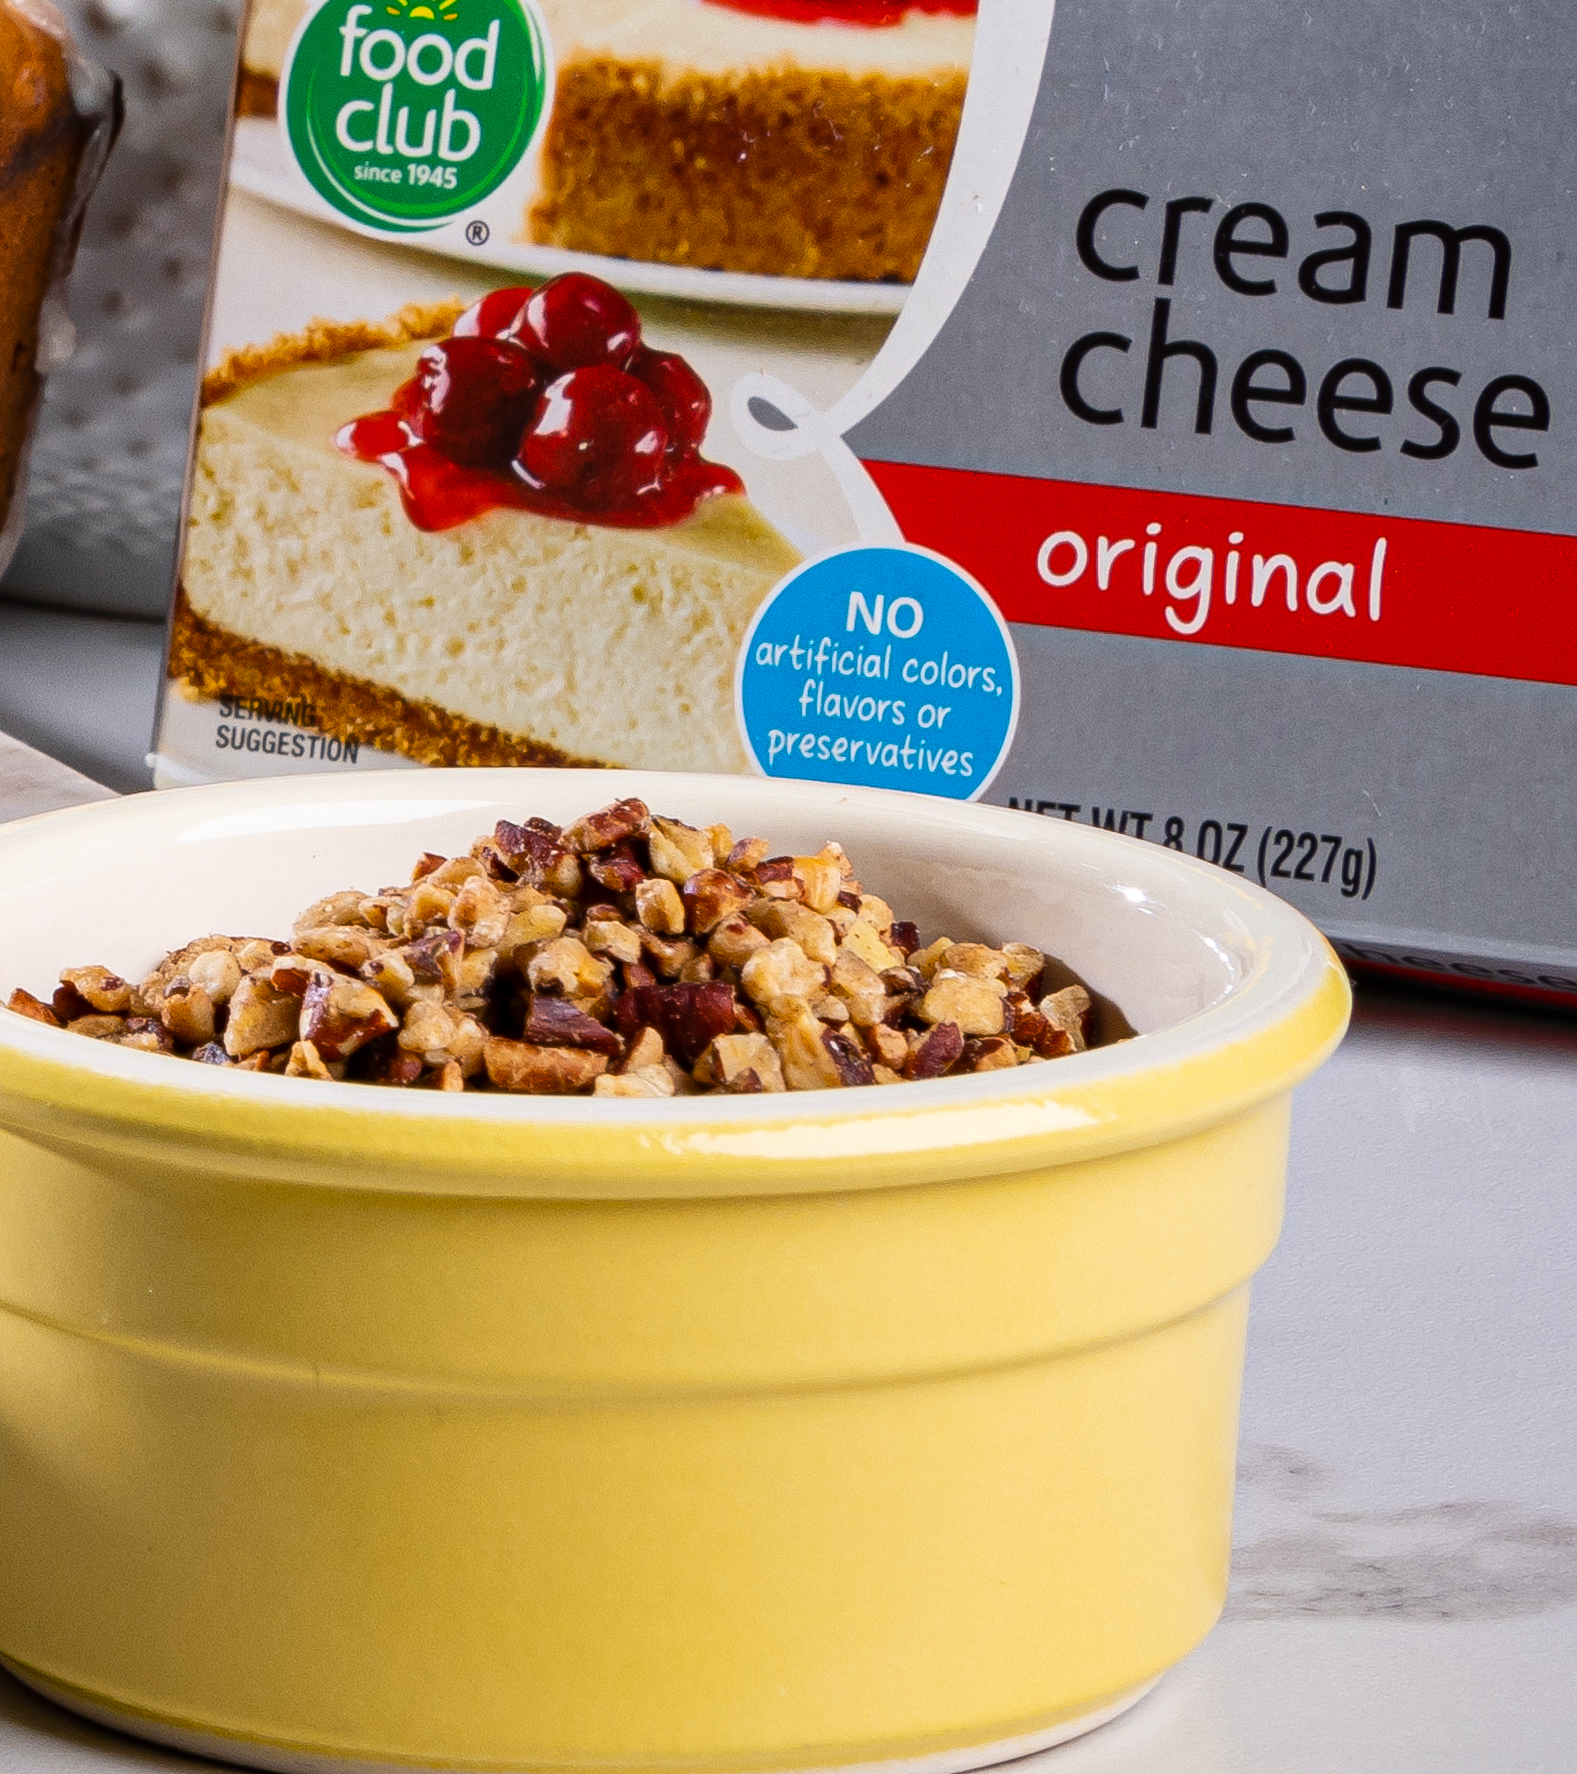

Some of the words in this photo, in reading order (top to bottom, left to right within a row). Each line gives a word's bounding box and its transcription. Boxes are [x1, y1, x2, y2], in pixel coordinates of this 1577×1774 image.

[338, 3, 501, 92] food
[334, 81, 482, 163] club
[353, 160, 403, 184] since
[406, 162, 458, 190] 1945
[1075, 187, 1513, 321] cream
[1058, 296, 1552, 471] cheese
[1036, 521, 1389, 634] original
[845, 590, 925, 639] NO
[755, 634, 892, 681] artificial
[901, 650, 1004, 697] colors,
[219, 694, 319, 728] SERVING
[798, 678, 906, 726] flavors
[917, 703, 952, 729] or
[215, 723, 362, 765] SUGGESTION
[767, 728, 974, 777] preservatives
[1195, 819, 1249, 874] OZ
[1257, 825, 1378, 902] (227g)
